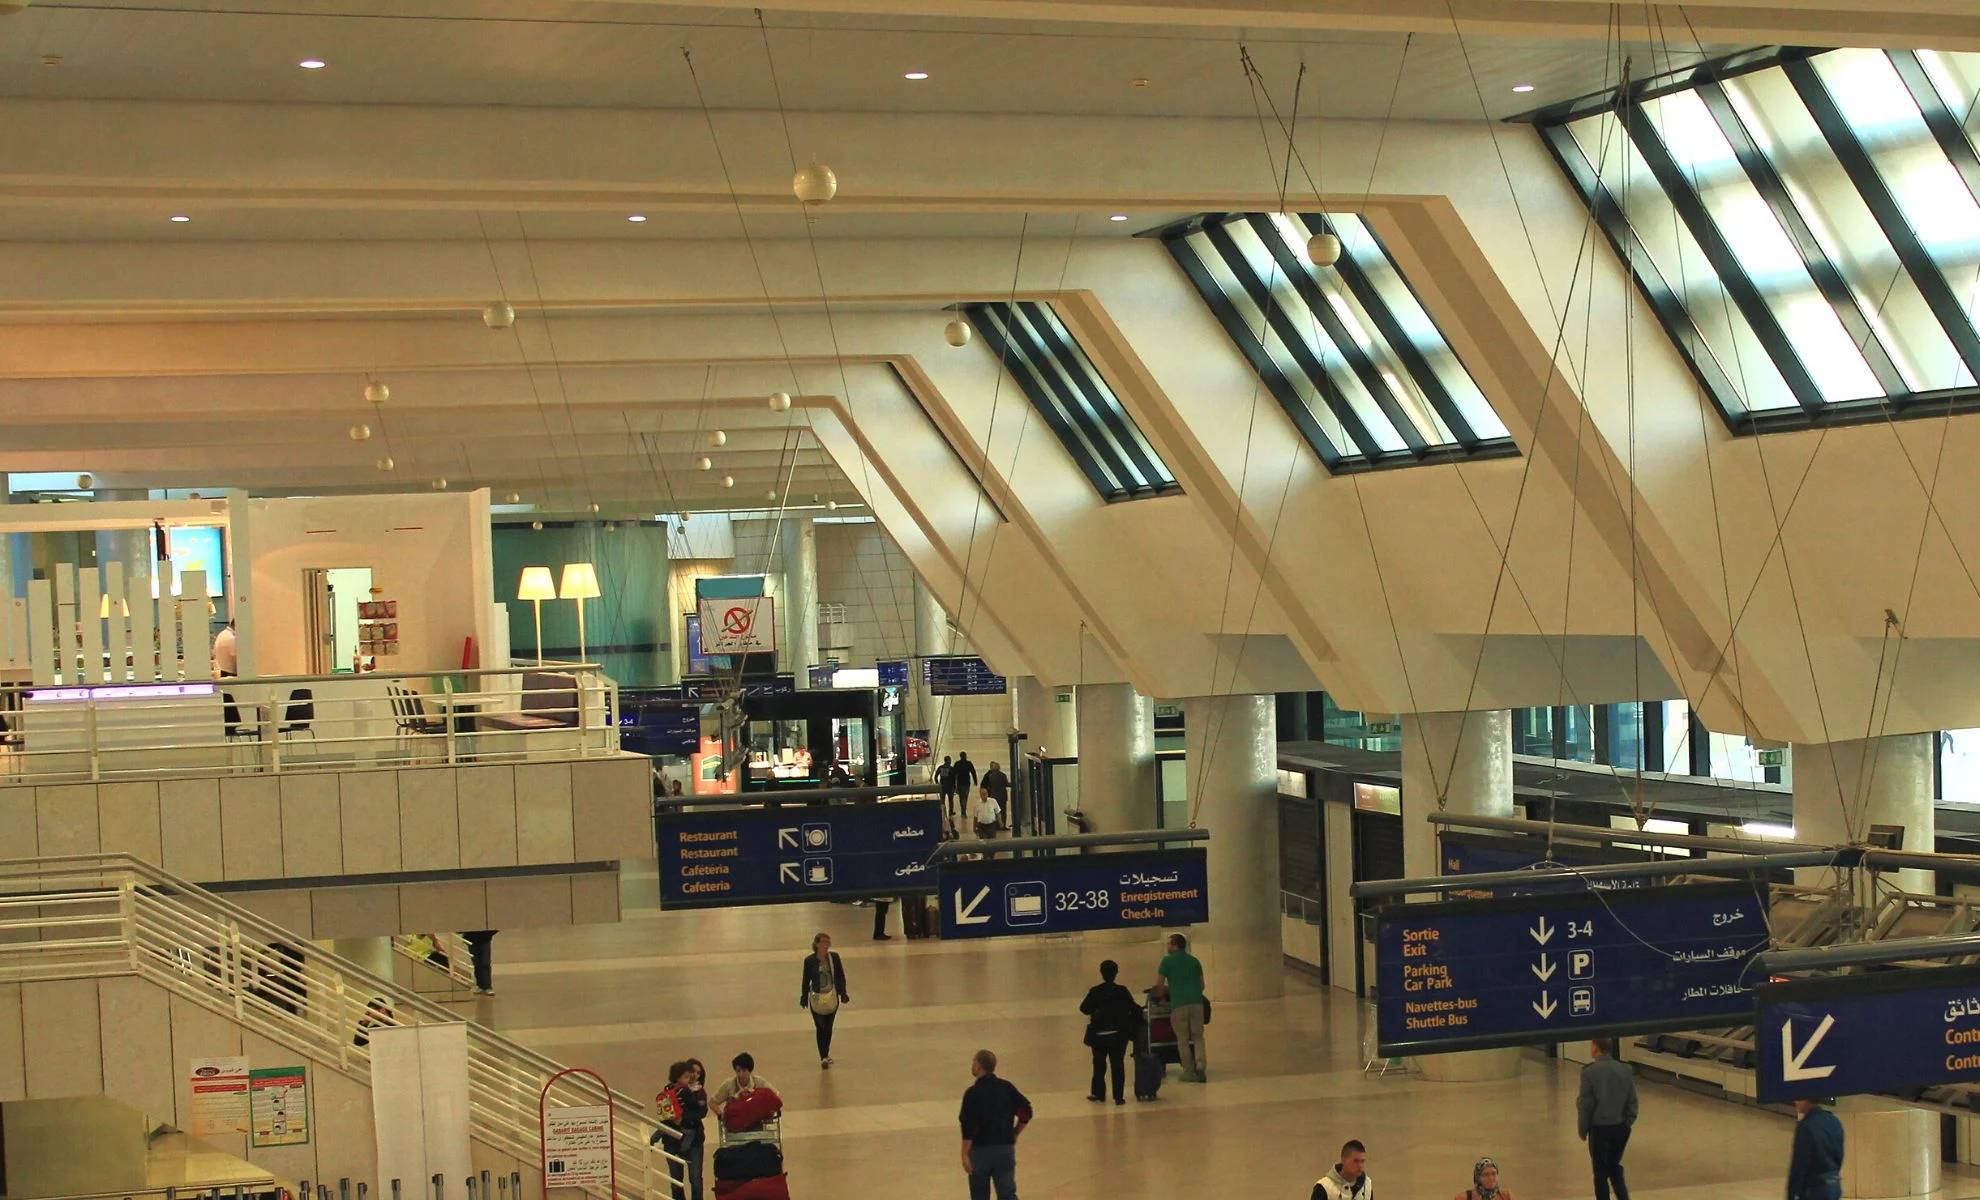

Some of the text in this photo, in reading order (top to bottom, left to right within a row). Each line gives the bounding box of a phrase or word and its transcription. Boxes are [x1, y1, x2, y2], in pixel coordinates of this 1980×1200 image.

[679, 830, 738, 843] Restaurant
[893, 826, 925, 841] مطعم
[681, 847, 739, 859] Restaurant
[1119, 870, 1179, 888] تسجيلات
[1055, 890, 1110, 911] 32-38
[1120, 889, 1199, 904] Enregistrement
[1121, 907, 1165, 920] Check-In
[1712, 908, 1745, 927] خروج
[1402, 927, 1441, 942] Sortie
[1567, 920, 1594, 939] 3-4
[1403, 943, 1428, 957] Exit
[1403, 964, 1449, 977] Parking
[1403, 977, 1453, 992] Car Park
[1681, 987, 1708, 1001] المطار
[1405, 997, 1478, 1014] Navettes-bus
[1406, 1013, 1468, 1030] Shuttle Bus
